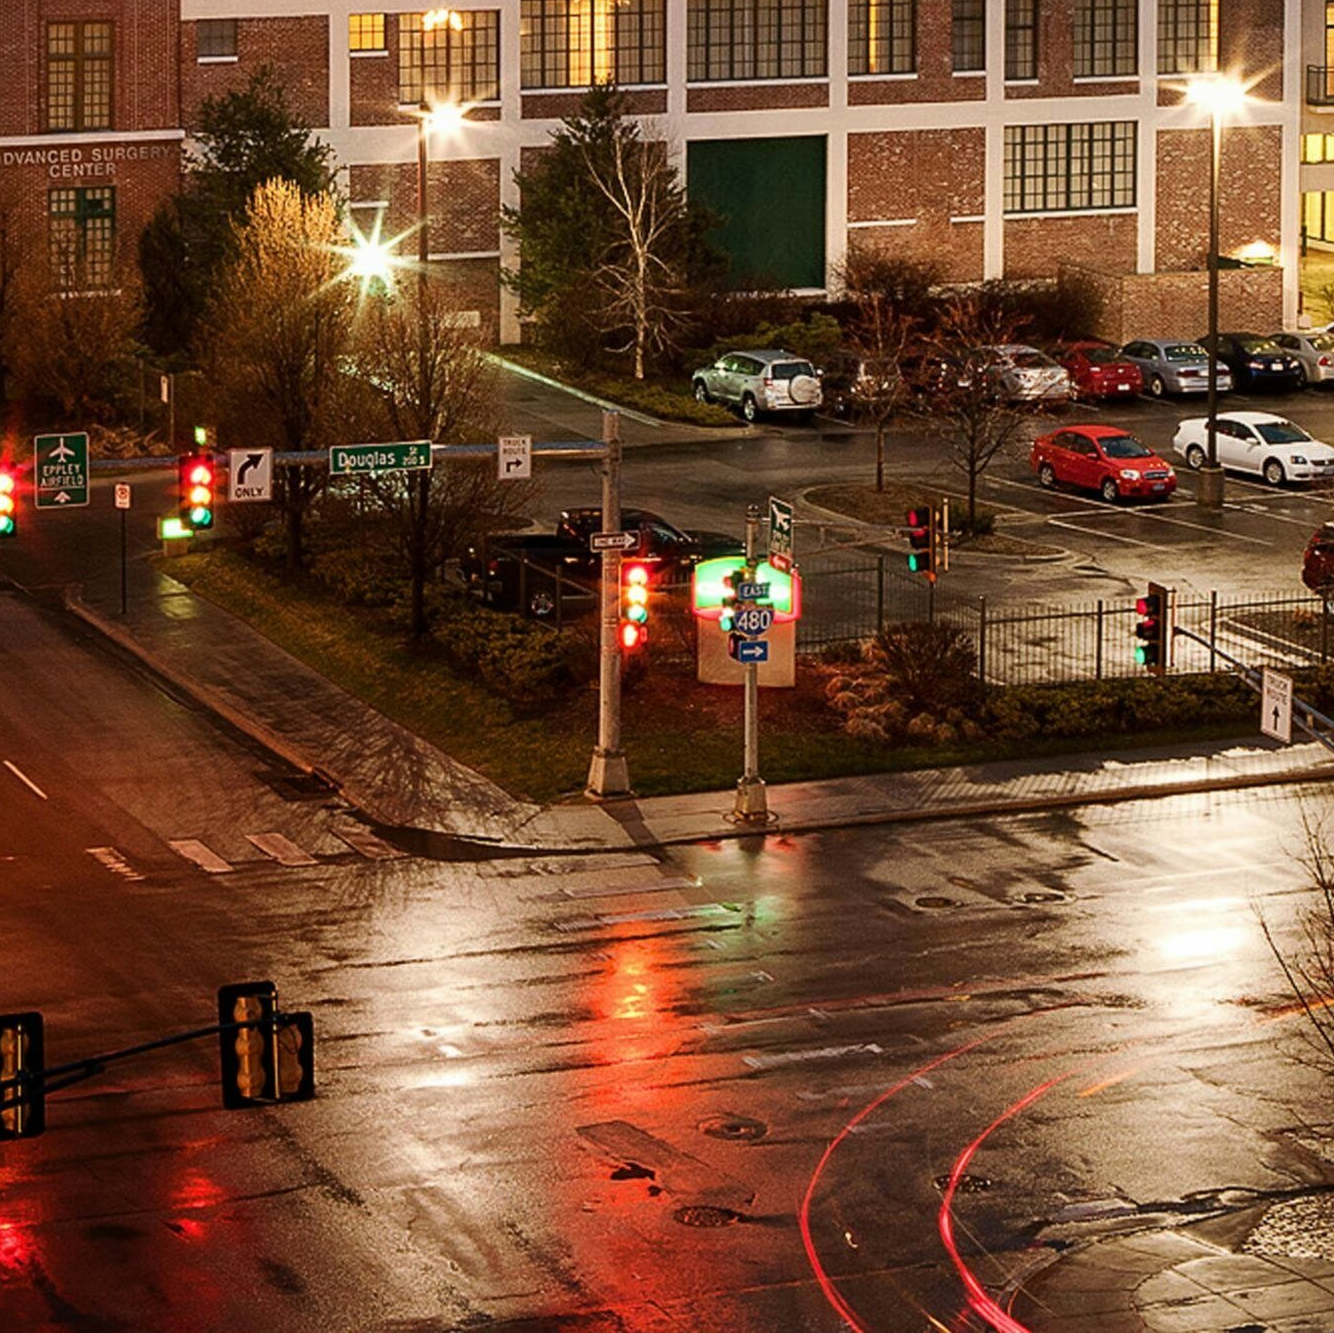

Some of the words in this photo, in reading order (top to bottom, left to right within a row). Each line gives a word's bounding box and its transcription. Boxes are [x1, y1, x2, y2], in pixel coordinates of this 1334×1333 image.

[91, 145, 170, 163] SURGERY
[48, 161, 117, 179] CENTER
[338, 450, 396, 469] Douglas
[42, 462, 82, 477] EPPLEY
[40, 474, 85, 488] AIRFIELD
[234, 486, 265, 499] ONLY
[742, 584, 768, 598] EAST
[738, 609, 771, 630] 480
